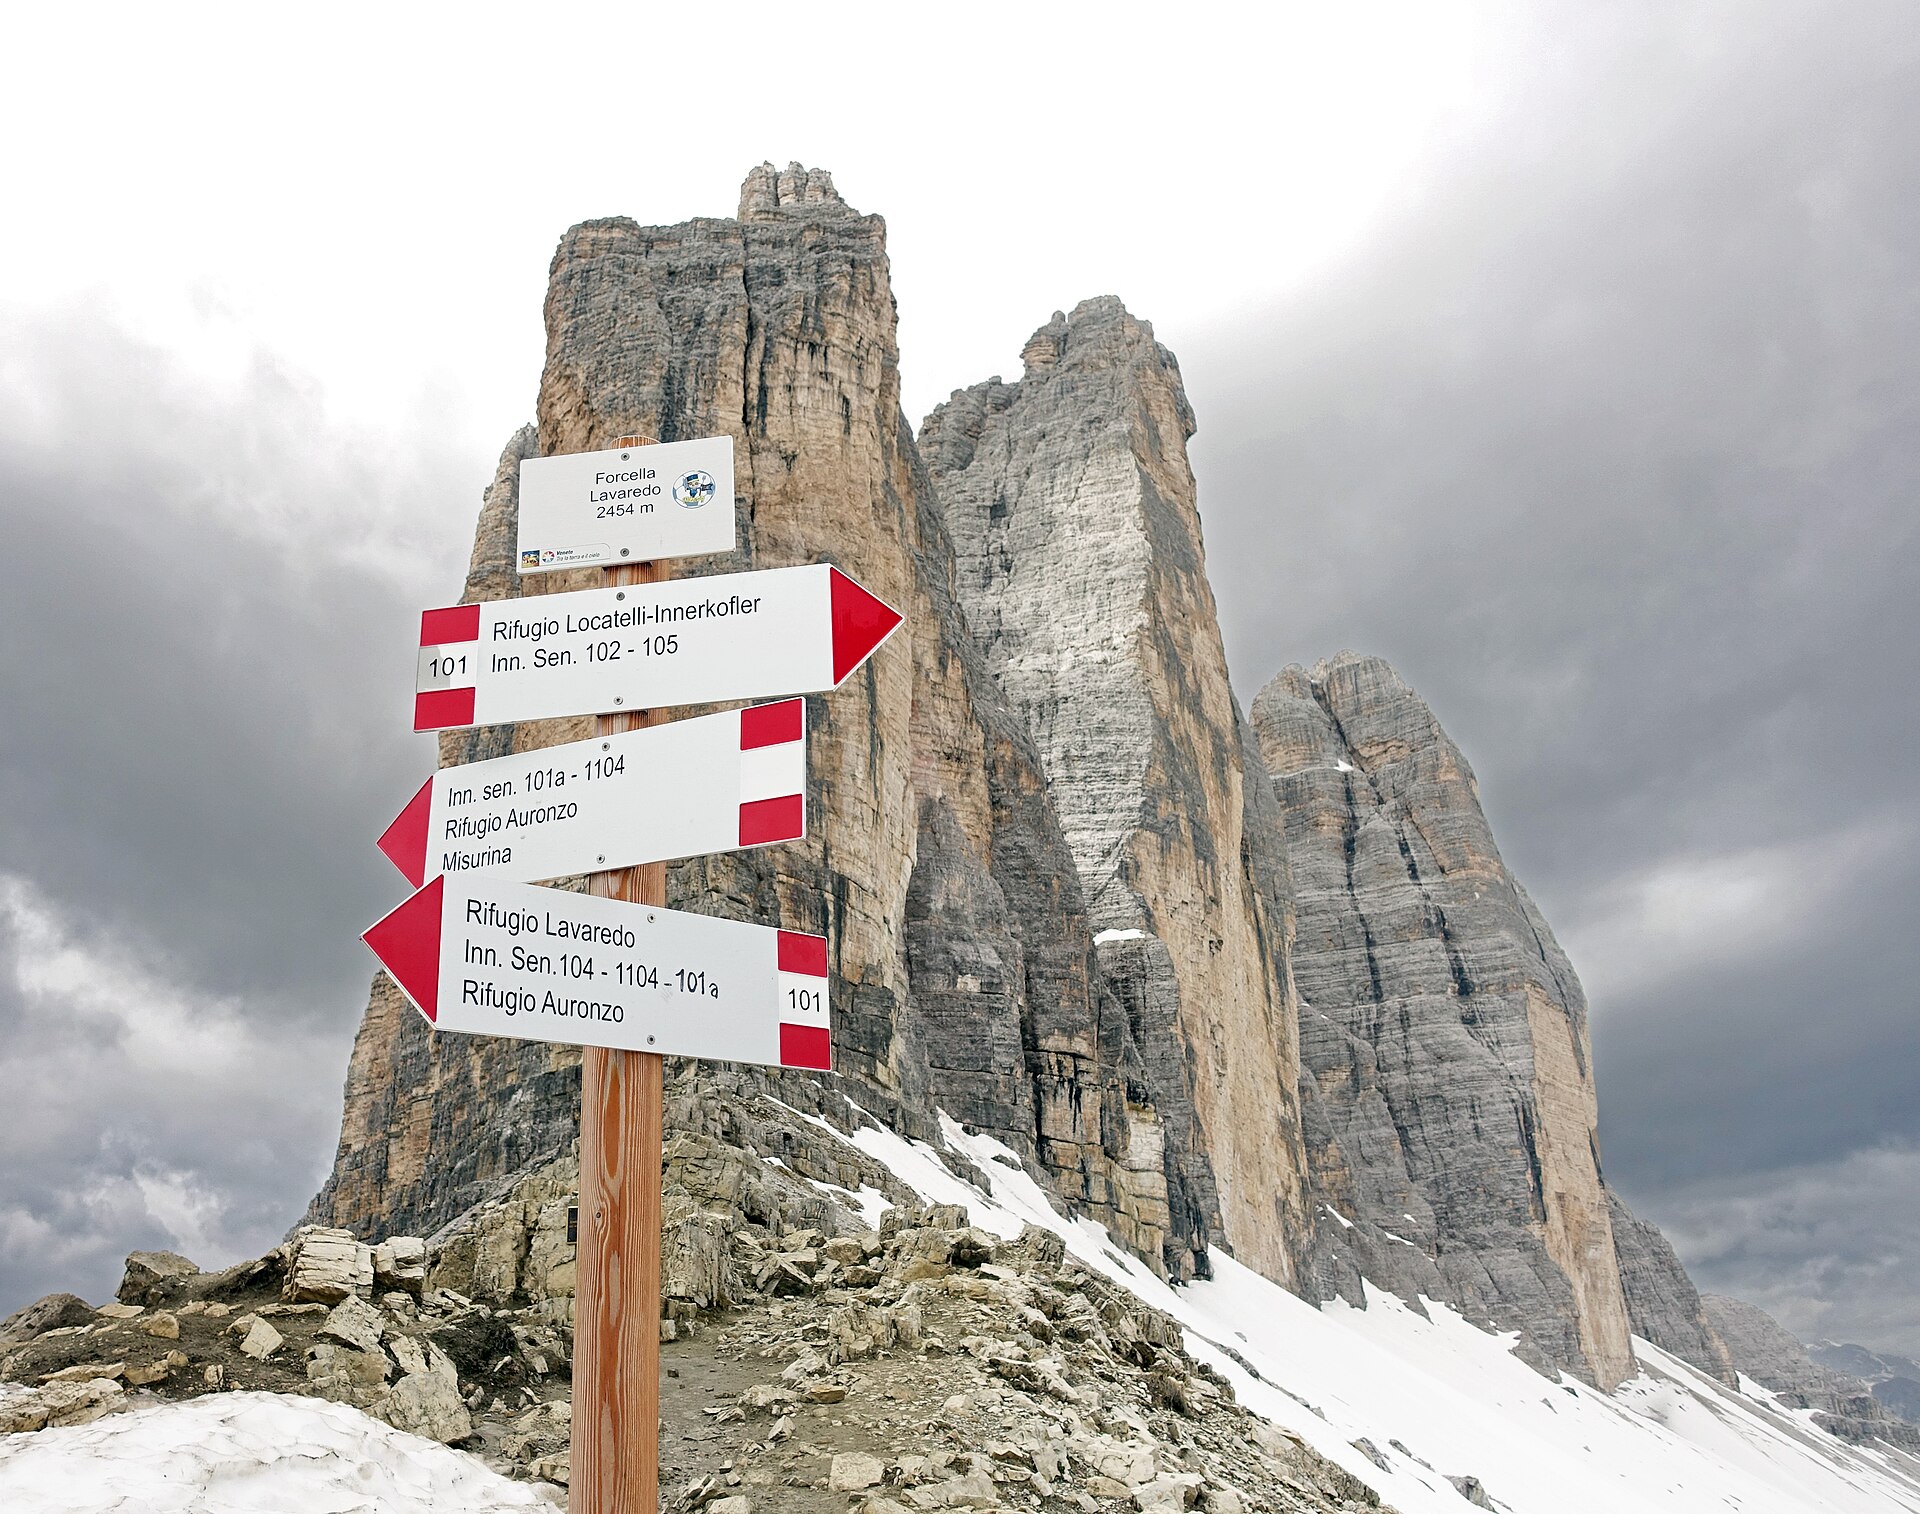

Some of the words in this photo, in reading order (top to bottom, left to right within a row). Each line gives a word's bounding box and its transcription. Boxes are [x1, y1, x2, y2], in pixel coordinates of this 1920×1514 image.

[591, 484, 661, 502] Lavaredo
[596, 468, 655, 484] Forcella
[597, 503, 634, 518] 2454
[494, 617, 559, 641] Rifugio
[567, 596, 761, 633] Locatelli-Innerkofler
[429, 656, 466, 677] 101
[492, 654, 525, 672] Inn.
[534, 649, 576, 668] Sen.
[587, 641, 620, 662] 102
[643, 635, 678, 656] 105
[449, 788, 476, 807] Inn.
[483, 782, 516, 800] sen.
[525, 768, 564, 792] 101a
[585, 754, 625, 780] 1104
[446, 813, 501, 840] Rifugio
[506, 803, 577, 829] Auronzo
[443, 846, 511, 871] Misurina
[467, 899, 538, 936] Rifugio
[546, 912, 635, 948] Lavaredo
[465, 939, 502, 967] Inn.
[616, 962, 658, 989] 1104
[463, 980, 535, 1016] Rifugio
[541, 991, 623, 1023] Auronzo
[789, 989, 819, 1012] 101
